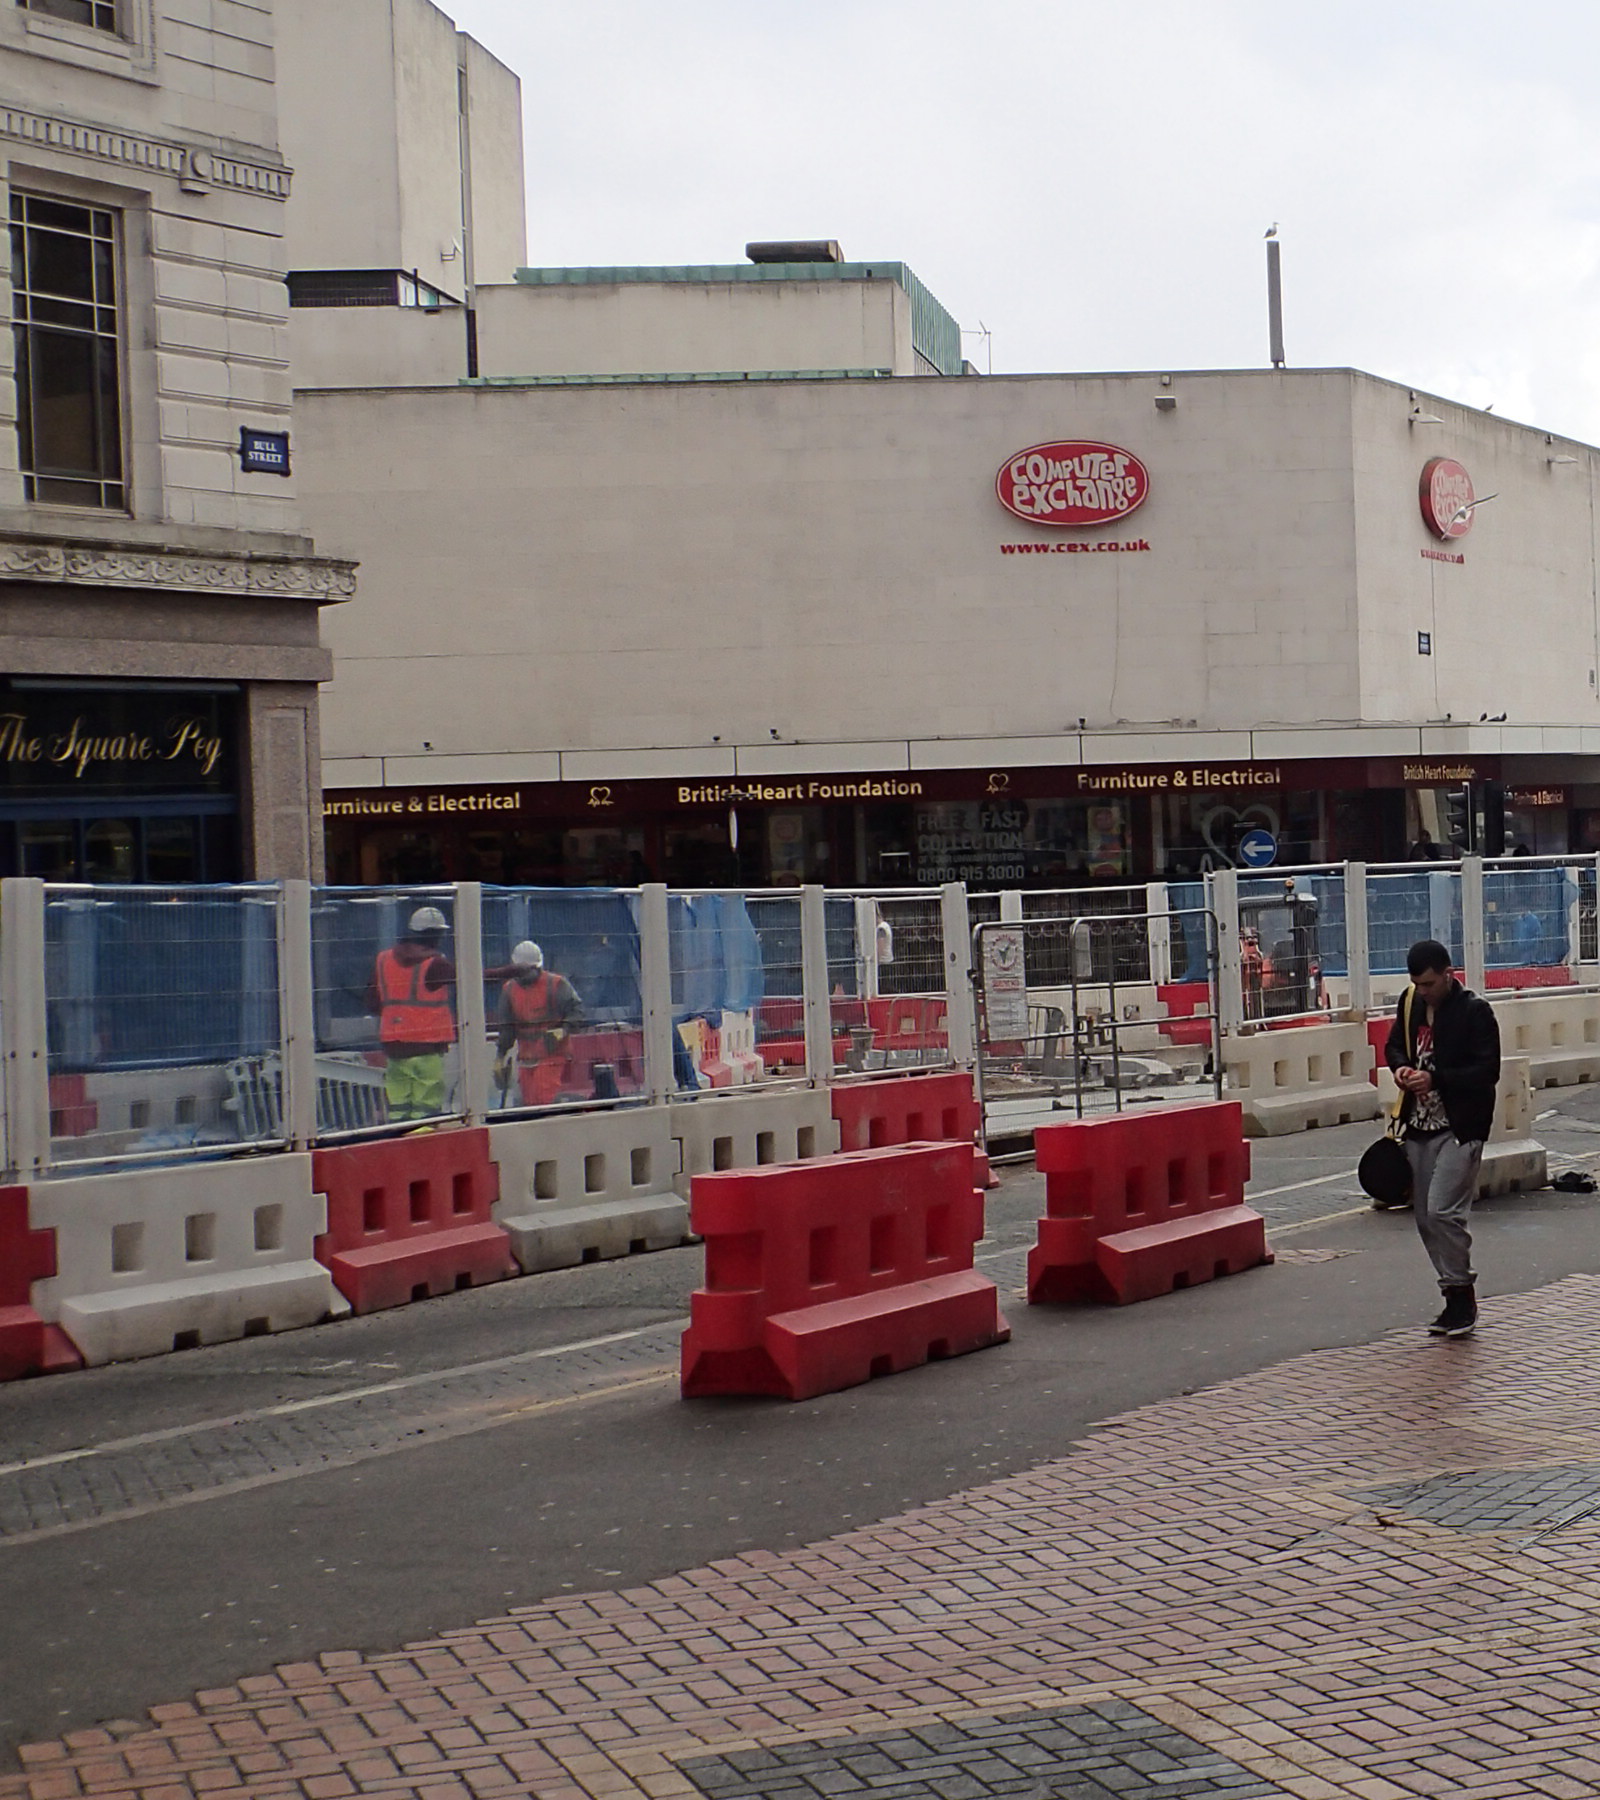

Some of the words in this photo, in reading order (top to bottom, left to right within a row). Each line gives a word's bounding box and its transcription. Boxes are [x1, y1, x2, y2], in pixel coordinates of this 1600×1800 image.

[253, 440, 277, 452] BULL
[248, 450, 282, 464] STREET
[1000, 539, 1150, 554] www.cex.co.uk
[0, 712, 42, 762] The
[48, 714, 152, 778] Square
[156, 711, 222, 775] Peg
[1077, 771, 1168, 790] Furniture
[1173, 770, 1188, 787] &
[1192, 767, 1281, 787] Electrical
[1403, 764, 1424, 780] British
[1424, 764, 1442, 780] Heart
[748, 783, 805, 801] Heart
[808, 779, 923, 798] Foundation
[322, 796, 404, 815] urniture
[407, 796, 423, 813] &
[427, 792, 520, 812] Electrical
[917, 810, 960, 831] FREE
[981, 809, 1024, 829] FAST
[918, 831, 1024, 852] COLLECTION
[917, 867, 956, 882] 0800
[959, 866, 983, 881] 915
[987, 864, 1024, 880] 3000
